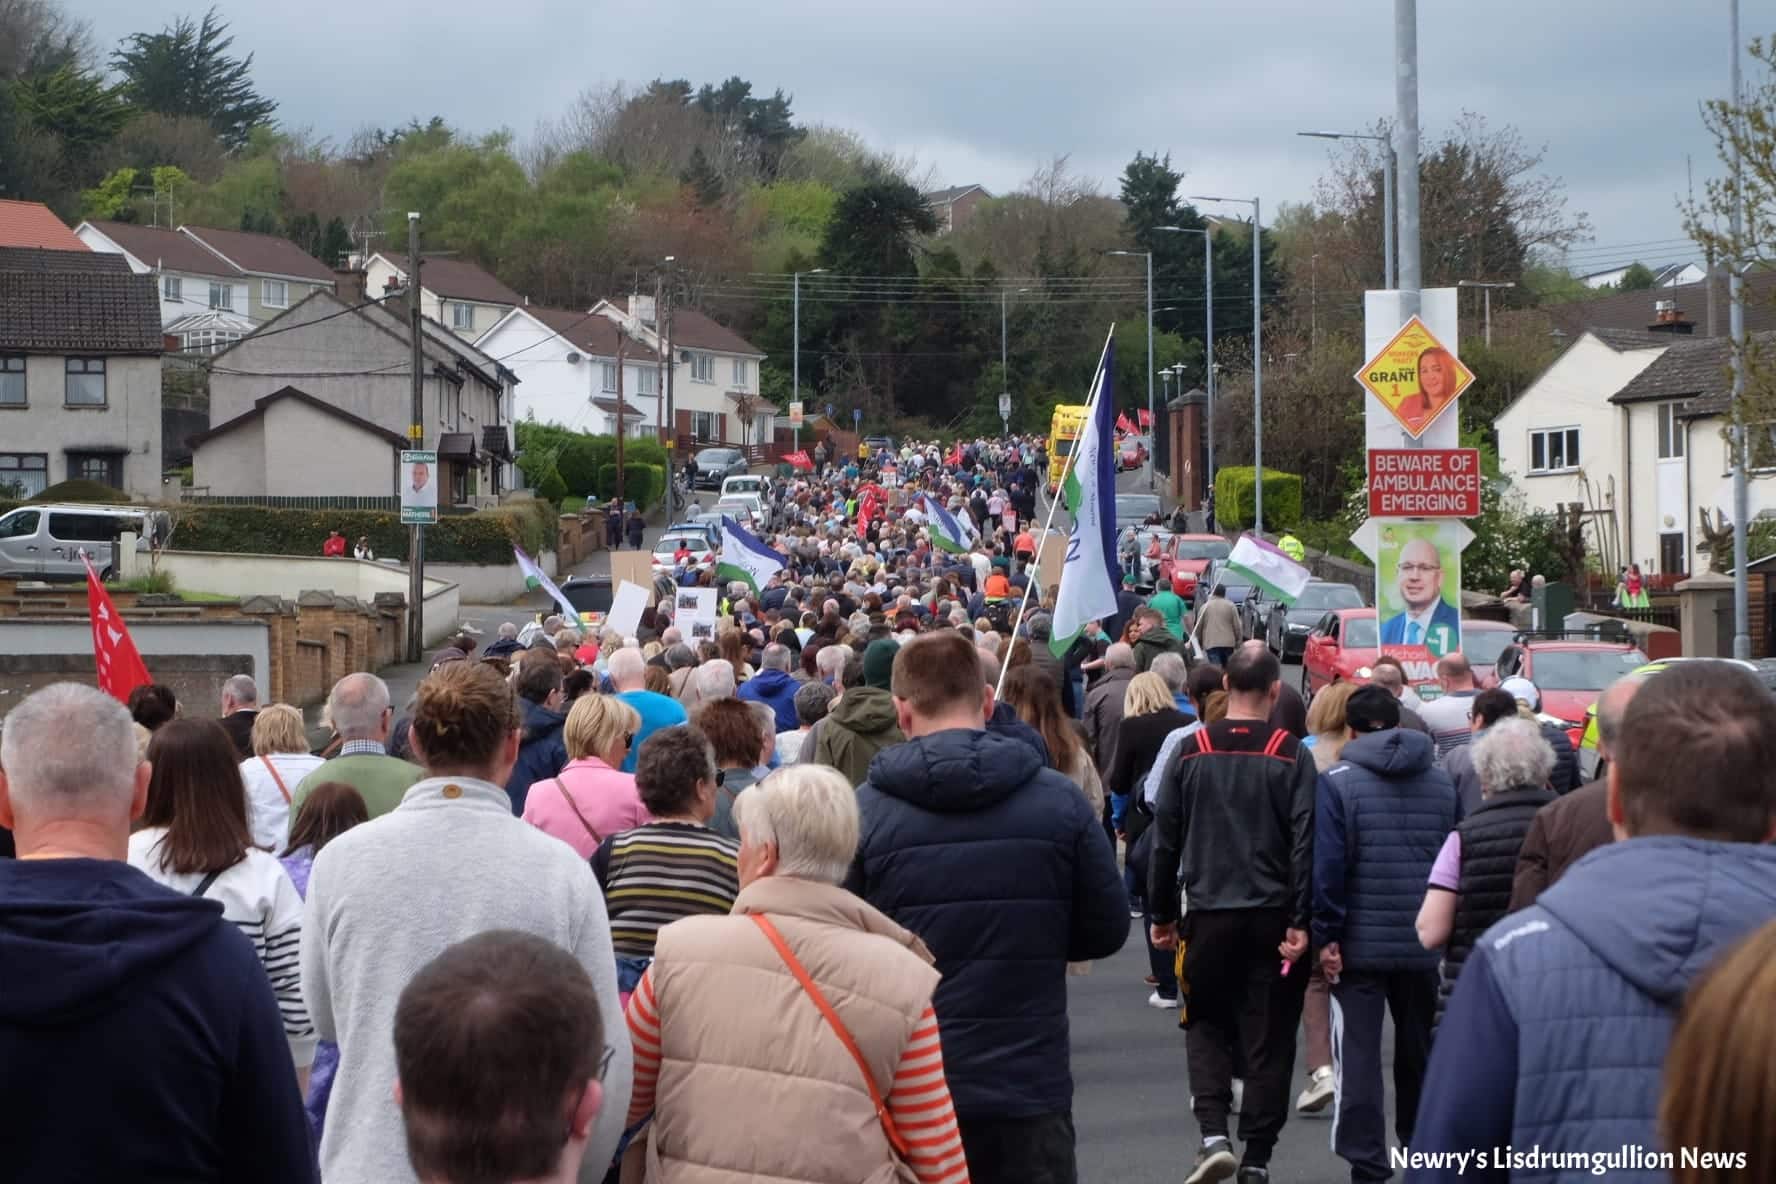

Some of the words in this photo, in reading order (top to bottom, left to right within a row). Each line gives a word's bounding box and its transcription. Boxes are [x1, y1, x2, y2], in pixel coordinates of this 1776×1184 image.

[1369, 371, 1416, 383] GRANT
[1391, 383, 1401, 397] 1
[1375, 455, 1442, 472] BEWARE
[1449, 454, 1472, 472] OF
[1372, 474, 1476, 491] AMBULANCE
[1381, 494, 1468, 511] EMERGING
[1436, 626, 1449, 655] 1
